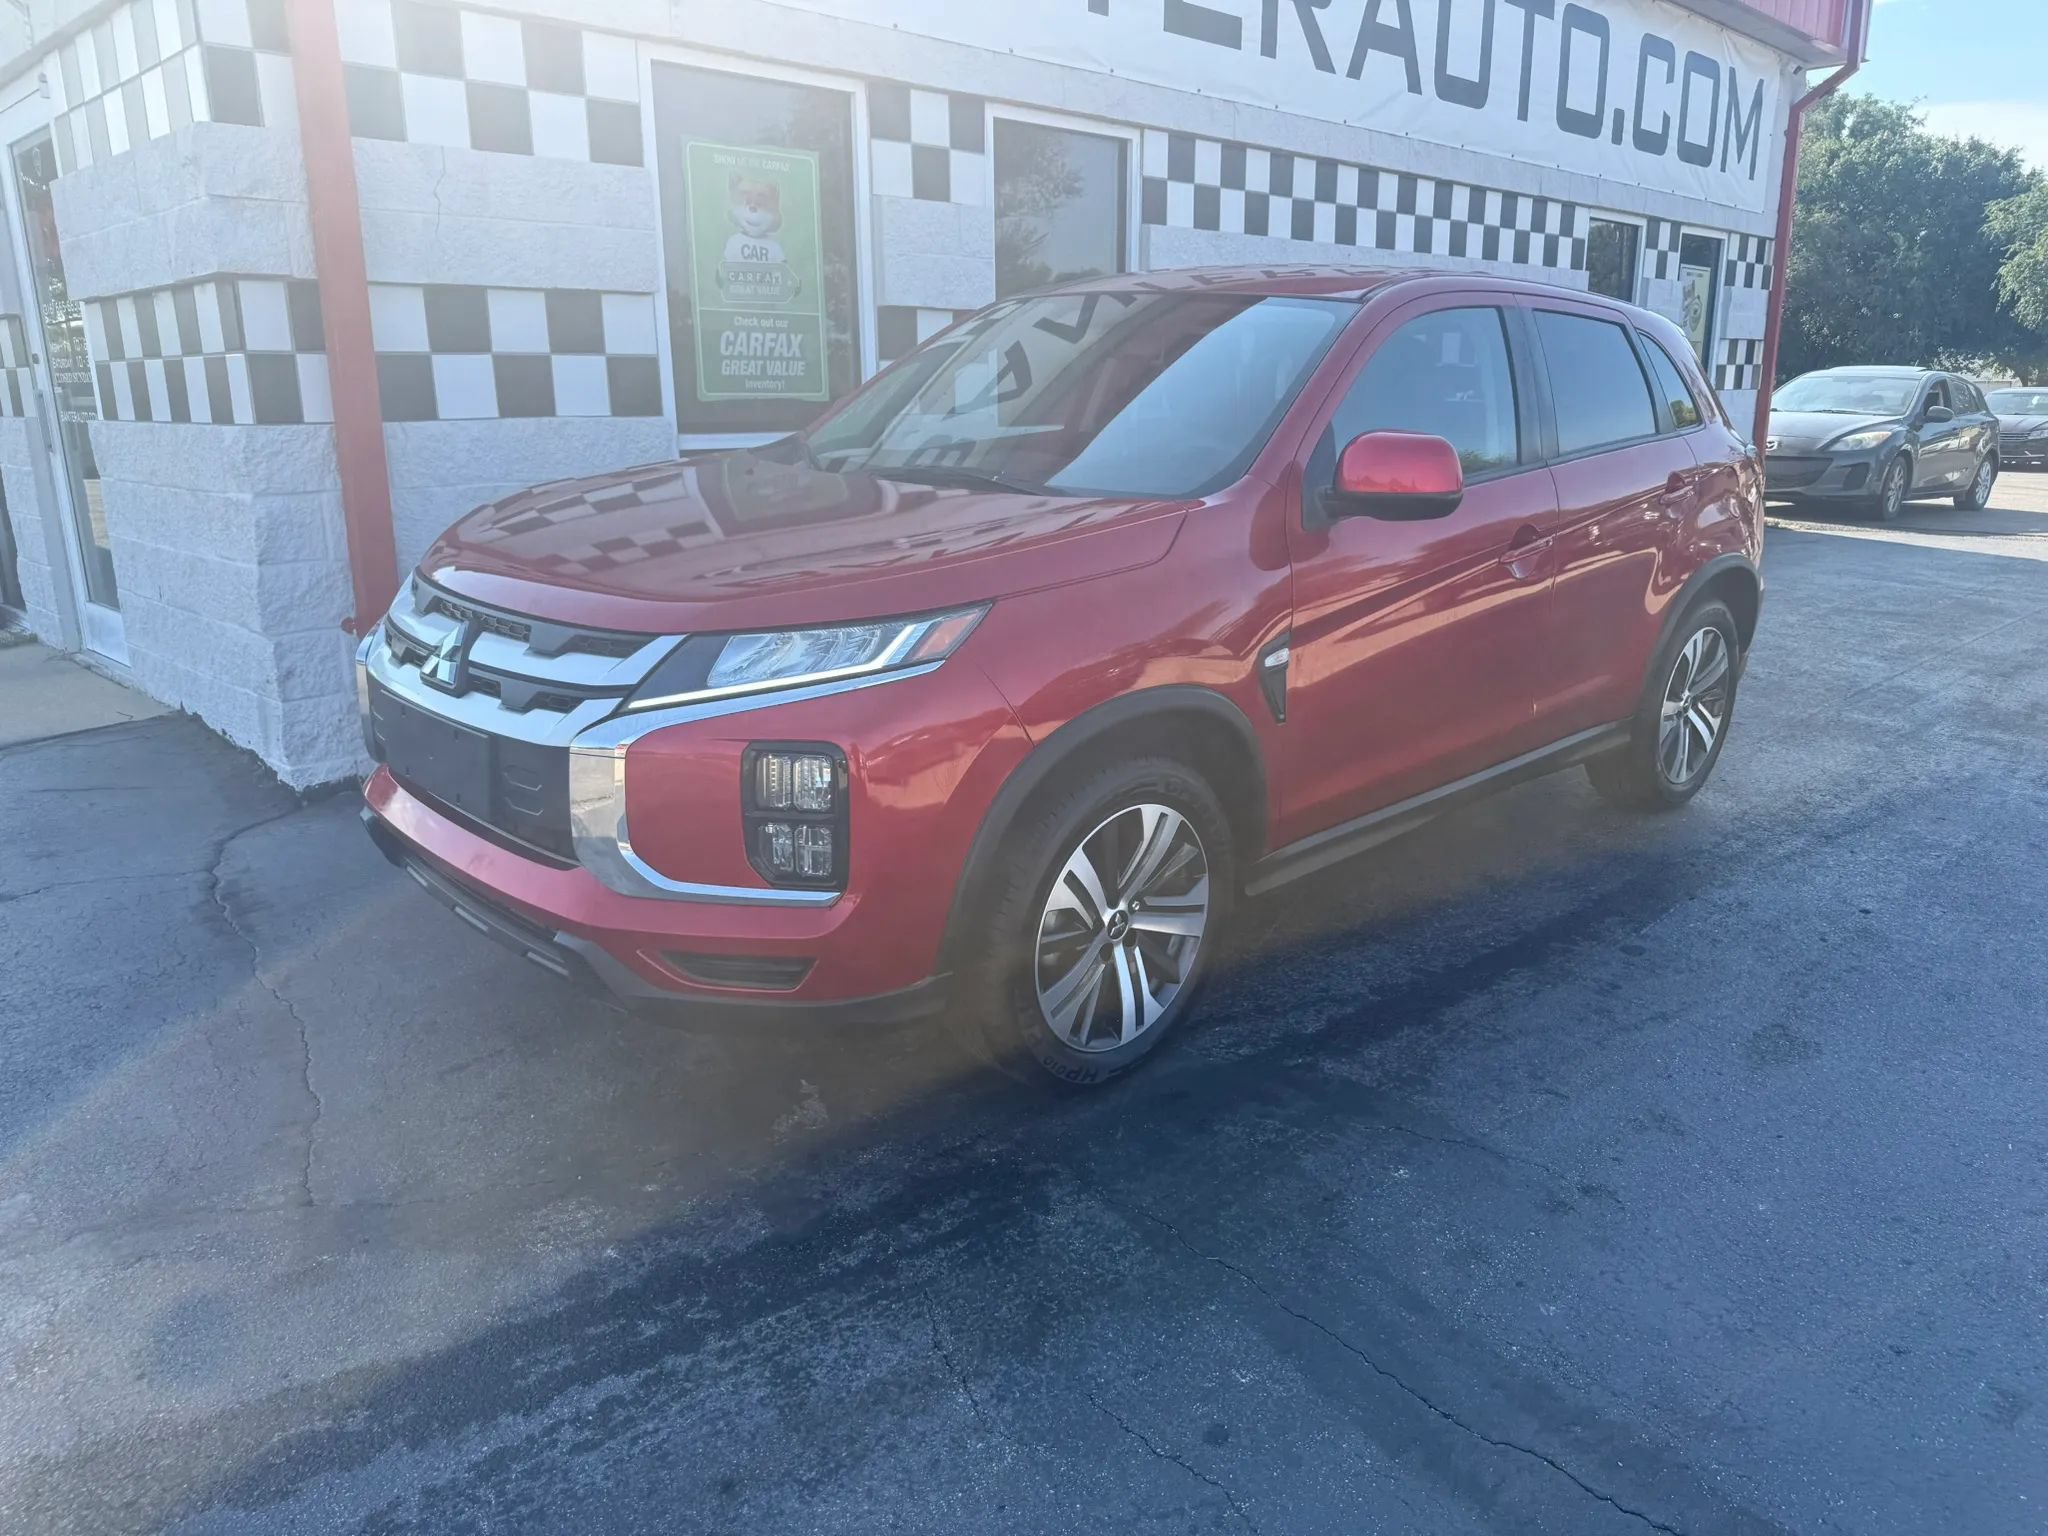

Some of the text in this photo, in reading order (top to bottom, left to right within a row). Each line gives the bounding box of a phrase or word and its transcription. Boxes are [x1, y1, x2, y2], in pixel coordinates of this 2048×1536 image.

[740, 243, 769, 262] CAR
[733, 315, 759, 327] Check
[760, 318, 774, 328] out
[720, 330, 804, 358] CARFAX
[721, 359, 806, 377] GREAT VALUE
